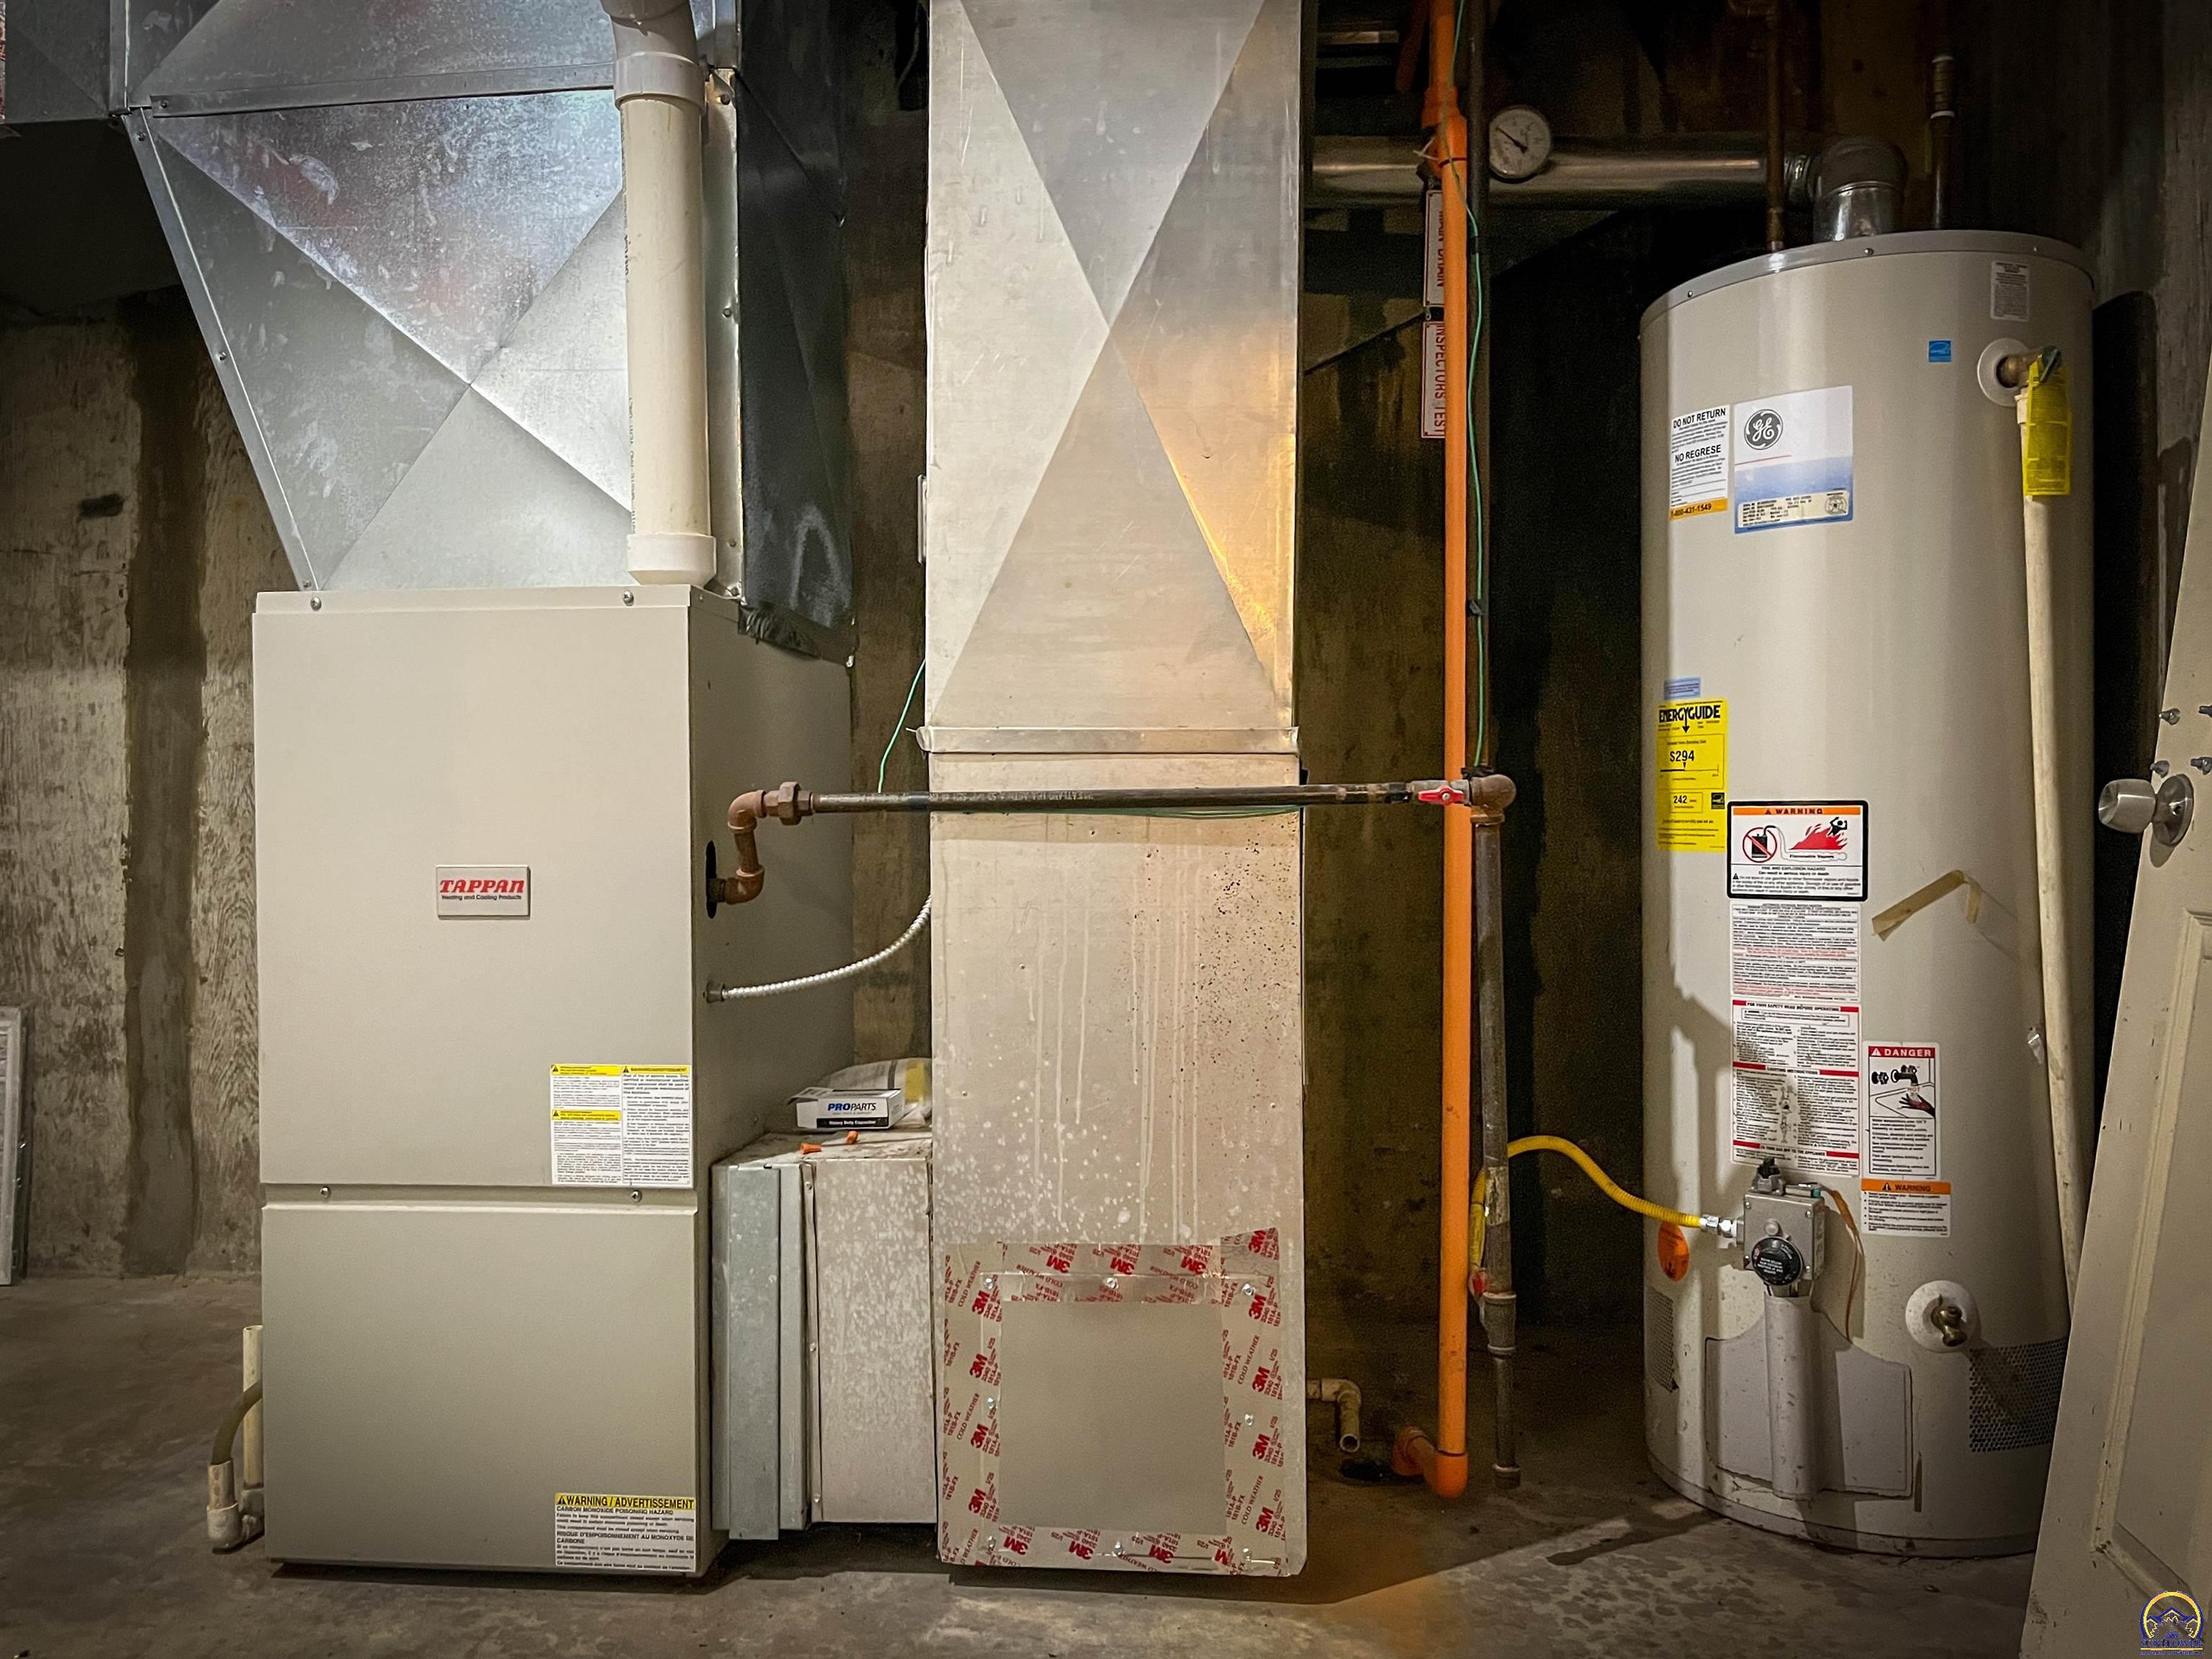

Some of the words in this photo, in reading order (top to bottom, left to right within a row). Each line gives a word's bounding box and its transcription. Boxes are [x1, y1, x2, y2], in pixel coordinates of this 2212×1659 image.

[1434, 324, 1445, 400] INSPECTORS
[1434, 404, 1445, 436] TEST
[1673, 418, 1681, 428] DO
[1683, 415, 1694, 426] NOT
[1696, 408, 1726, 422] RETURN
[1675, 453, 1684, 462] NO
[1686, 444, 1722, 459] REGRESE
[1659, 705, 1721, 722] ENERGYGUIDE
[1673, 795, 1687, 804] 242
[439, 879, 525, 894] TAPPAN
[1884, 1048, 1932, 1057] DANGER
[827, 1102, 877, 1111] PROPARTS
[1249, 1230, 1267, 1253] 3M
[1046, 1254, 1071, 1274] 3M
[1110, 1256, 1135, 1275] 3M
[1180, 1255, 1206, 1275] 3M
[972, 1290, 990, 1314] 3M
[1249, 1294, 1267, 1319] 3M
[969, 1353, 988, 1378] 3M
[1238, 1367, 1248, 1385] COLD
[1246, 1335, 1260, 1366] WEATHER
[1252, 1366, 1270, 1392] 3M
[971, 1423, 989, 1449] 3M
[1252, 1434, 1270, 1460] 3M
[567, 1496, 608, 1506] WARNING
[609, 1496, 613, 1506] /
[615, 1496, 694, 1509] ADVERTISSEMENT
[968, 1488, 986, 1513] 3M
[1256, 1506, 1274, 1532] 3M
[1004, 1536, 1028, 1555] 3M
[1069, 1540, 1094, 1560] 3M
[1149, 1545, 1174, 1564] 3M
